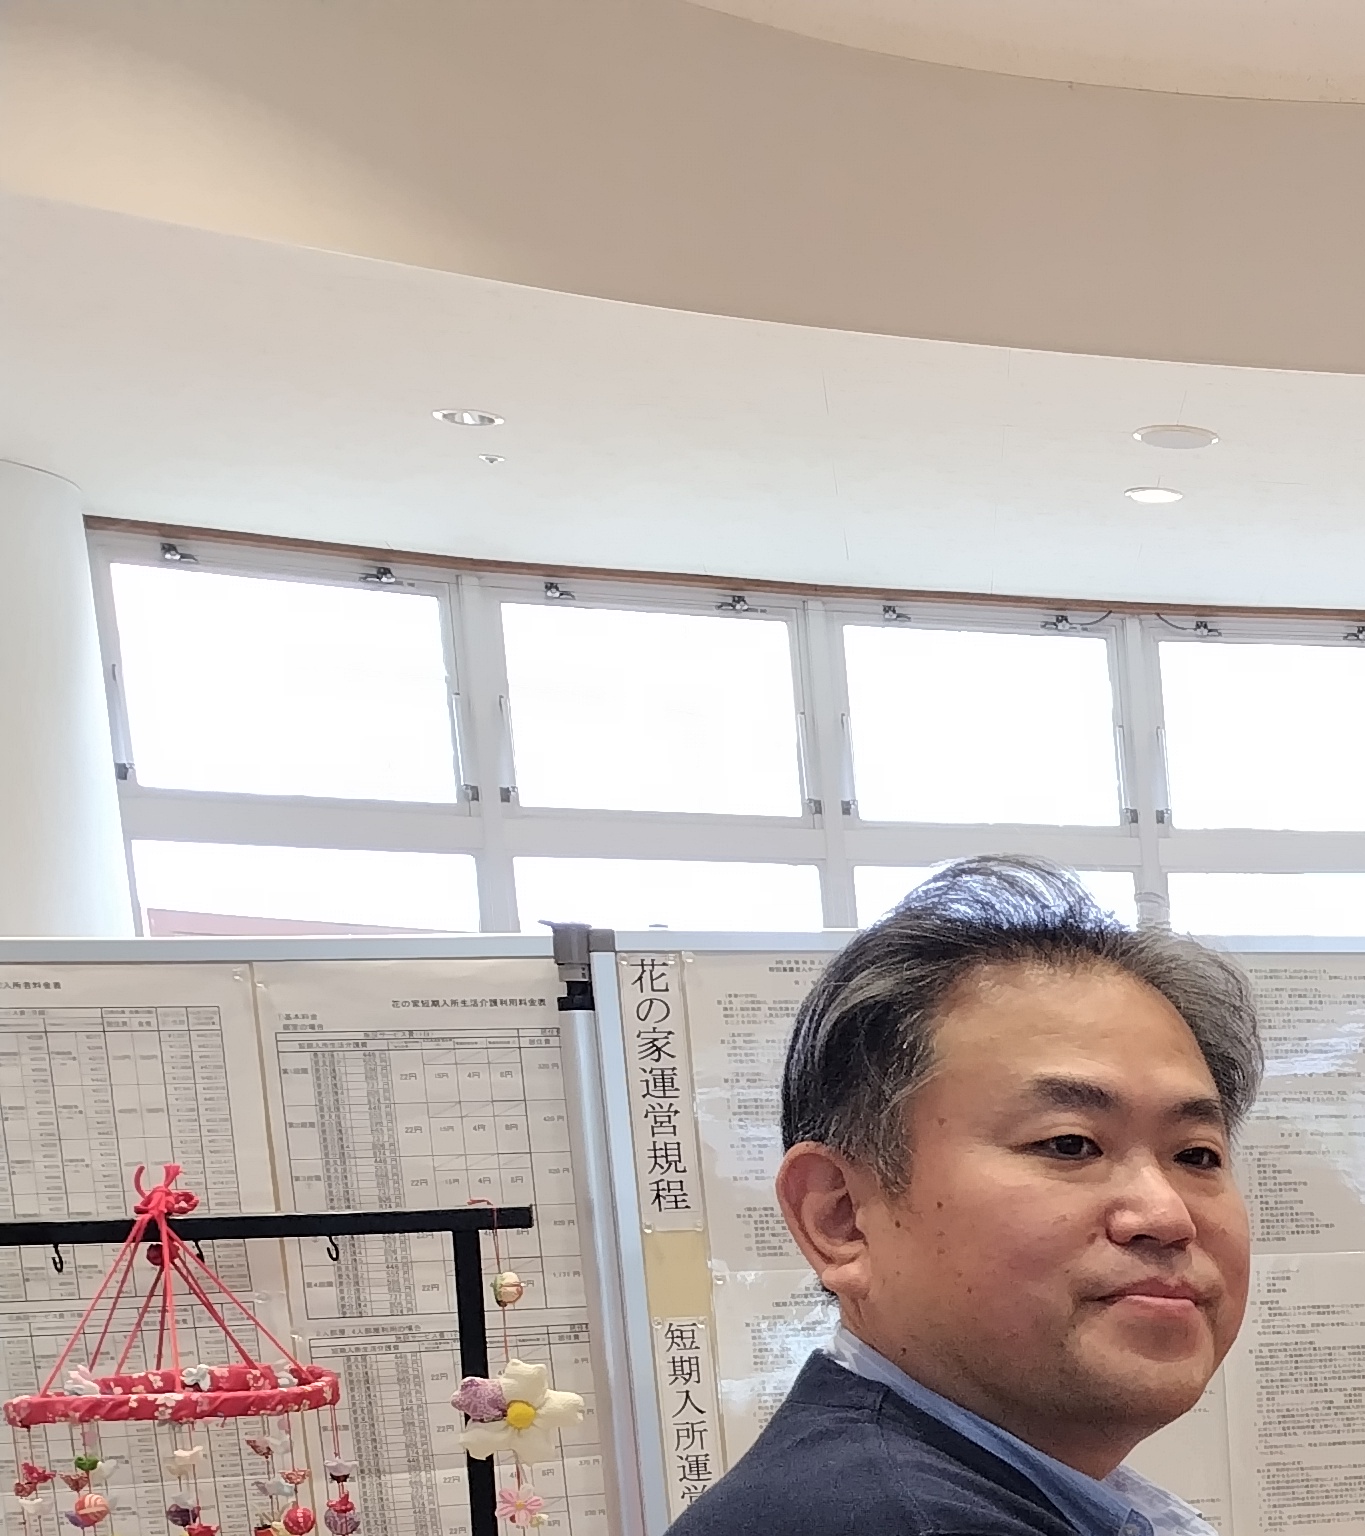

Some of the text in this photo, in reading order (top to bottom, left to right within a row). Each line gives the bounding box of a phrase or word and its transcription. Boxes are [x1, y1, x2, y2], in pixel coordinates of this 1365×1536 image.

[629, 958, 692, 1214] 花の家運営規程
